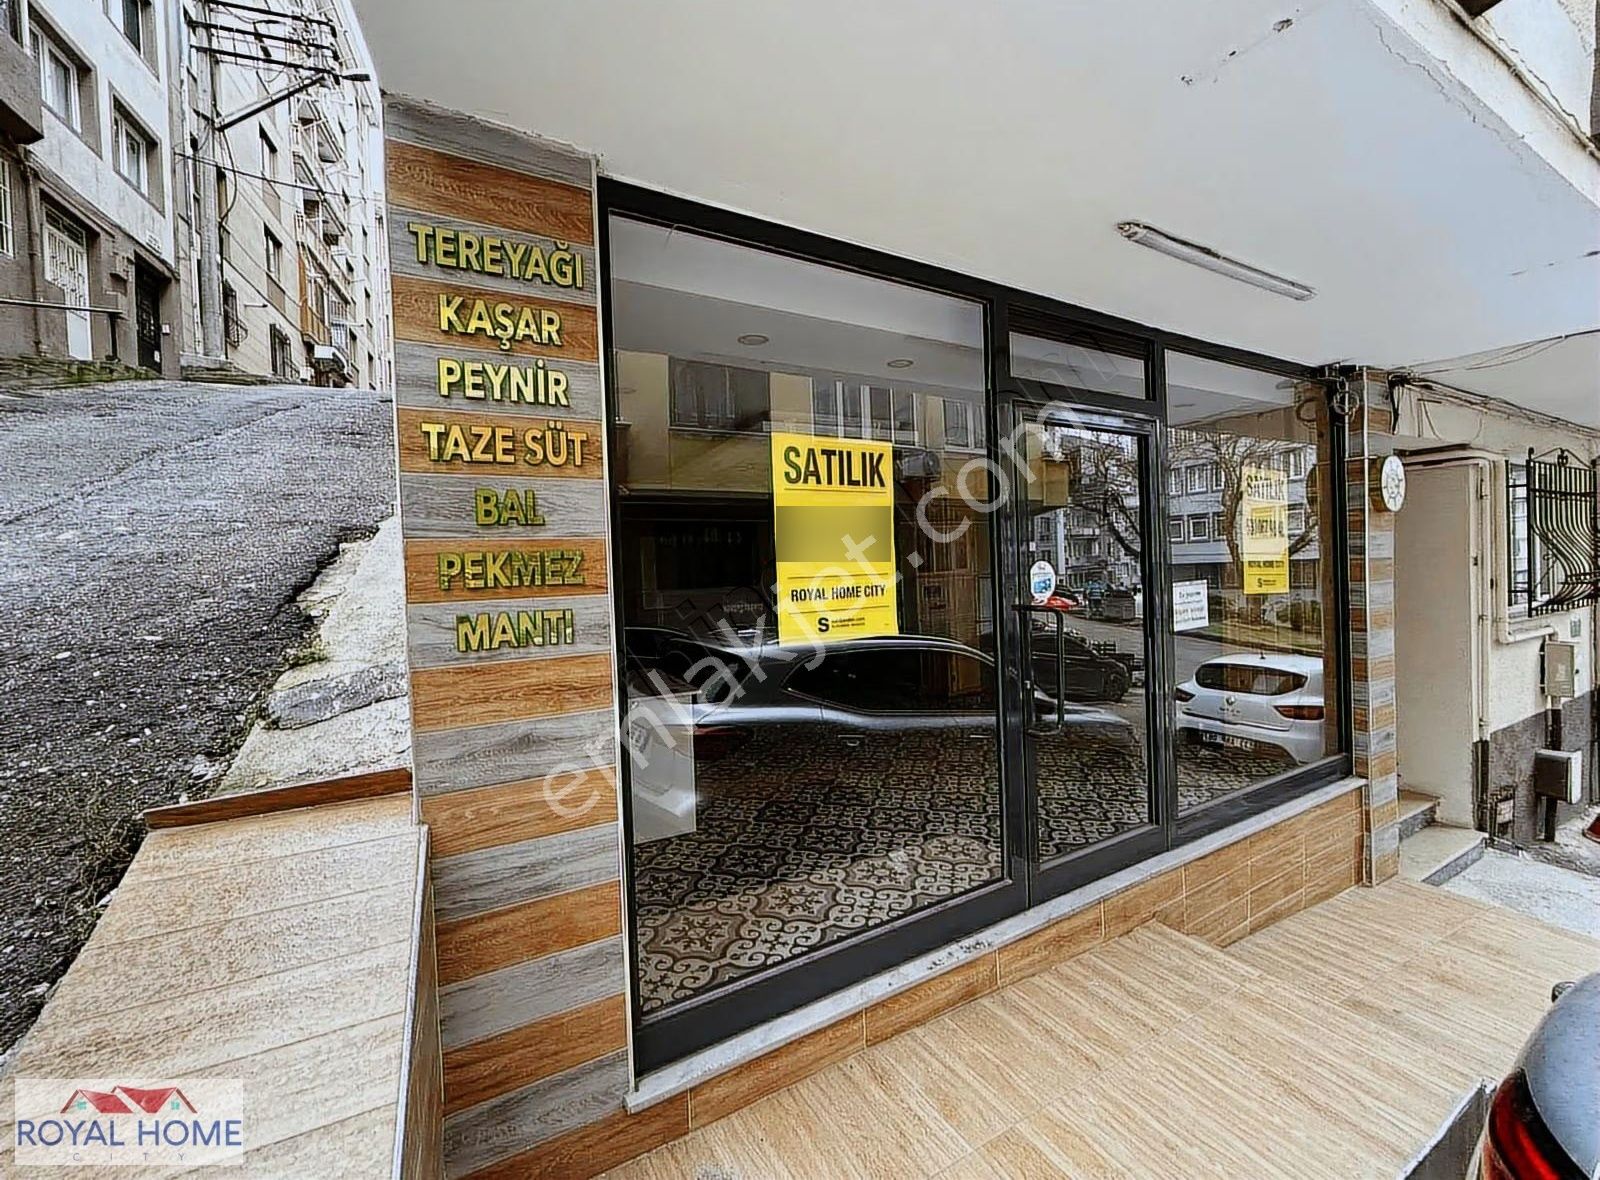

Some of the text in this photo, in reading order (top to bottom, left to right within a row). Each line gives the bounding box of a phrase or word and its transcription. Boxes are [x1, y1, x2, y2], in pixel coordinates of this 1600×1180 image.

[408, 222, 585, 290] TEREYAĞI
[438, 294, 563, 350] KAŞAR
[437, 359, 570, 407] PEYNİR
[421, 421, 588, 467] TAZE SÜT
[783, 446, 887, 488] SATILIK
[474, 488, 546, 527] BAL
[438, 550, 586, 591] PEKMEZ
[790, 584, 886, 602] ROYAL HOME CITY
[456, 609, 575, 653] MANTI
